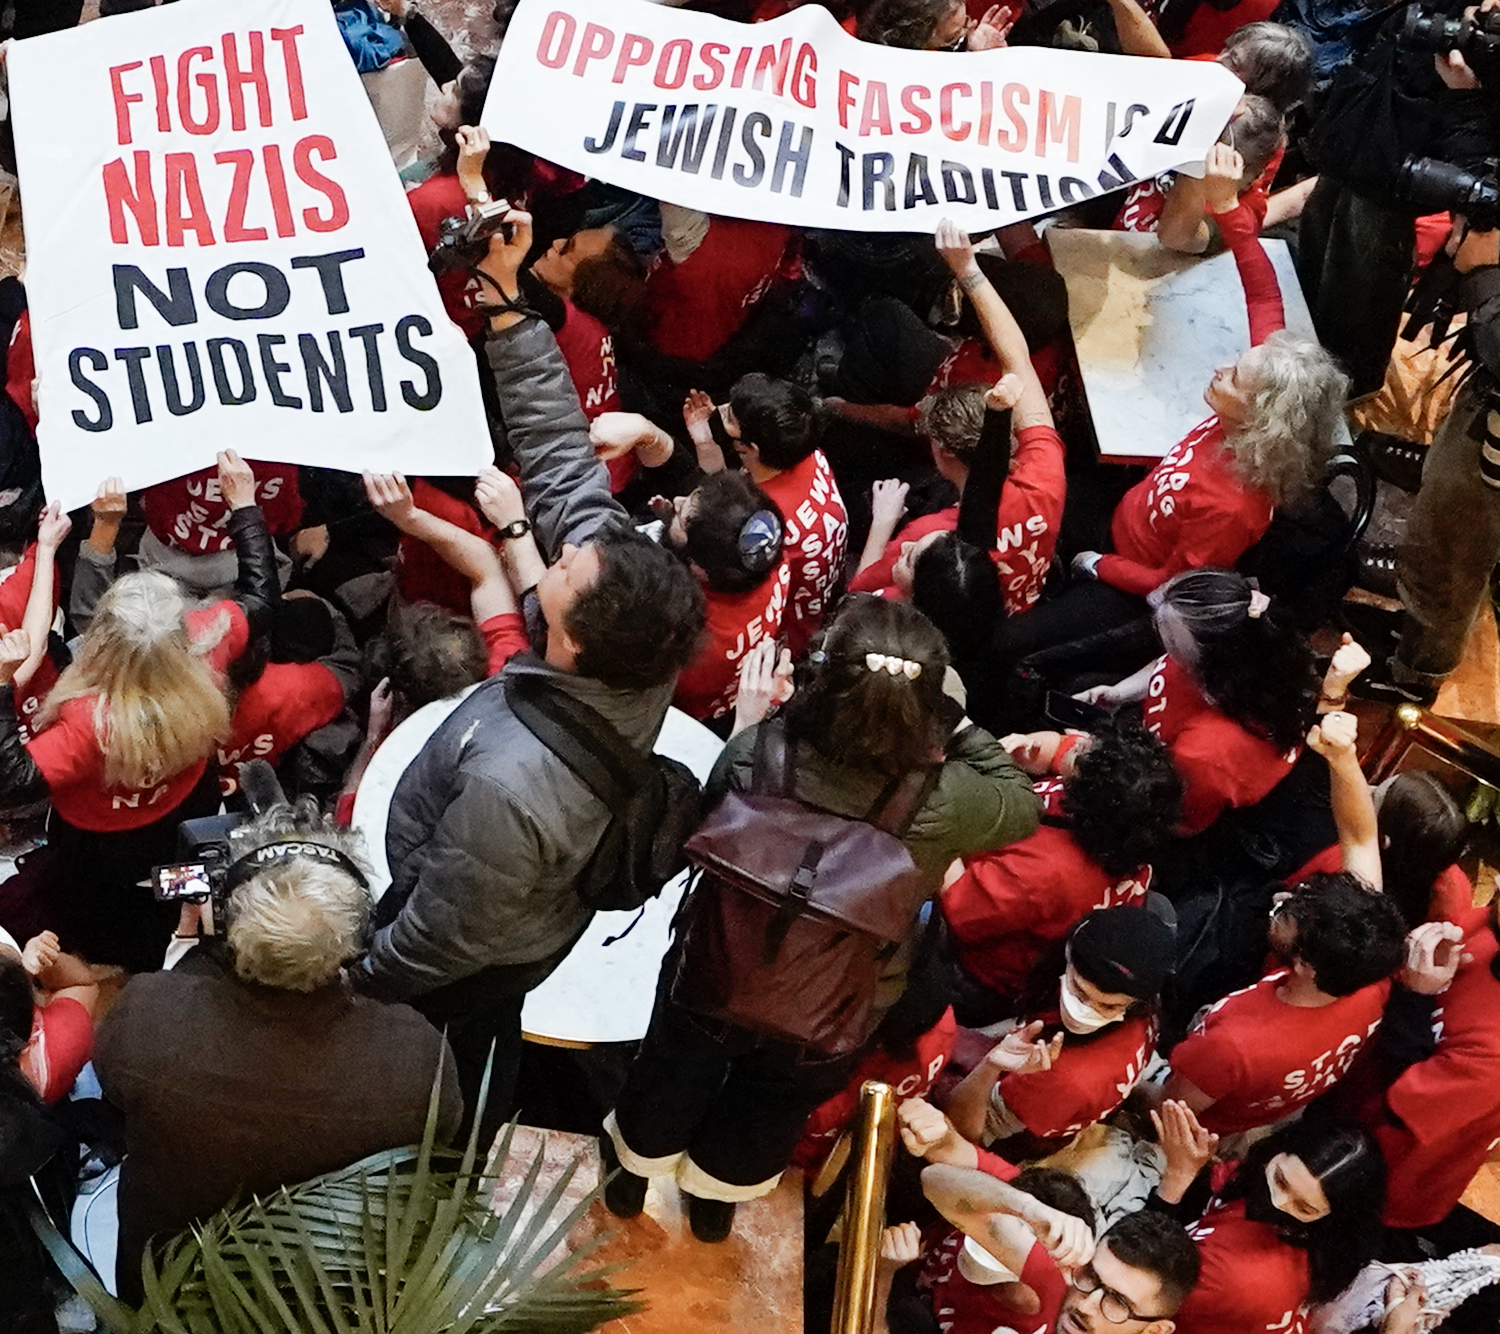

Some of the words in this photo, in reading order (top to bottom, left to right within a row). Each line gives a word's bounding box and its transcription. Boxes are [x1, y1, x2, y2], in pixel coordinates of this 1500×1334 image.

[108, 24, 308, 145] FIGHT
[534, 9, 819, 110] OPPOSING
[838, 69, 1083, 163] FASCISM
[102, 134, 350, 247] NAZIS
[583, 101, 814, 199] JEWISH
[112, 248, 365, 329] NOT
[67, 315, 443, 433] STUDENTS
[256, 839, 343, 867] TASCAM
